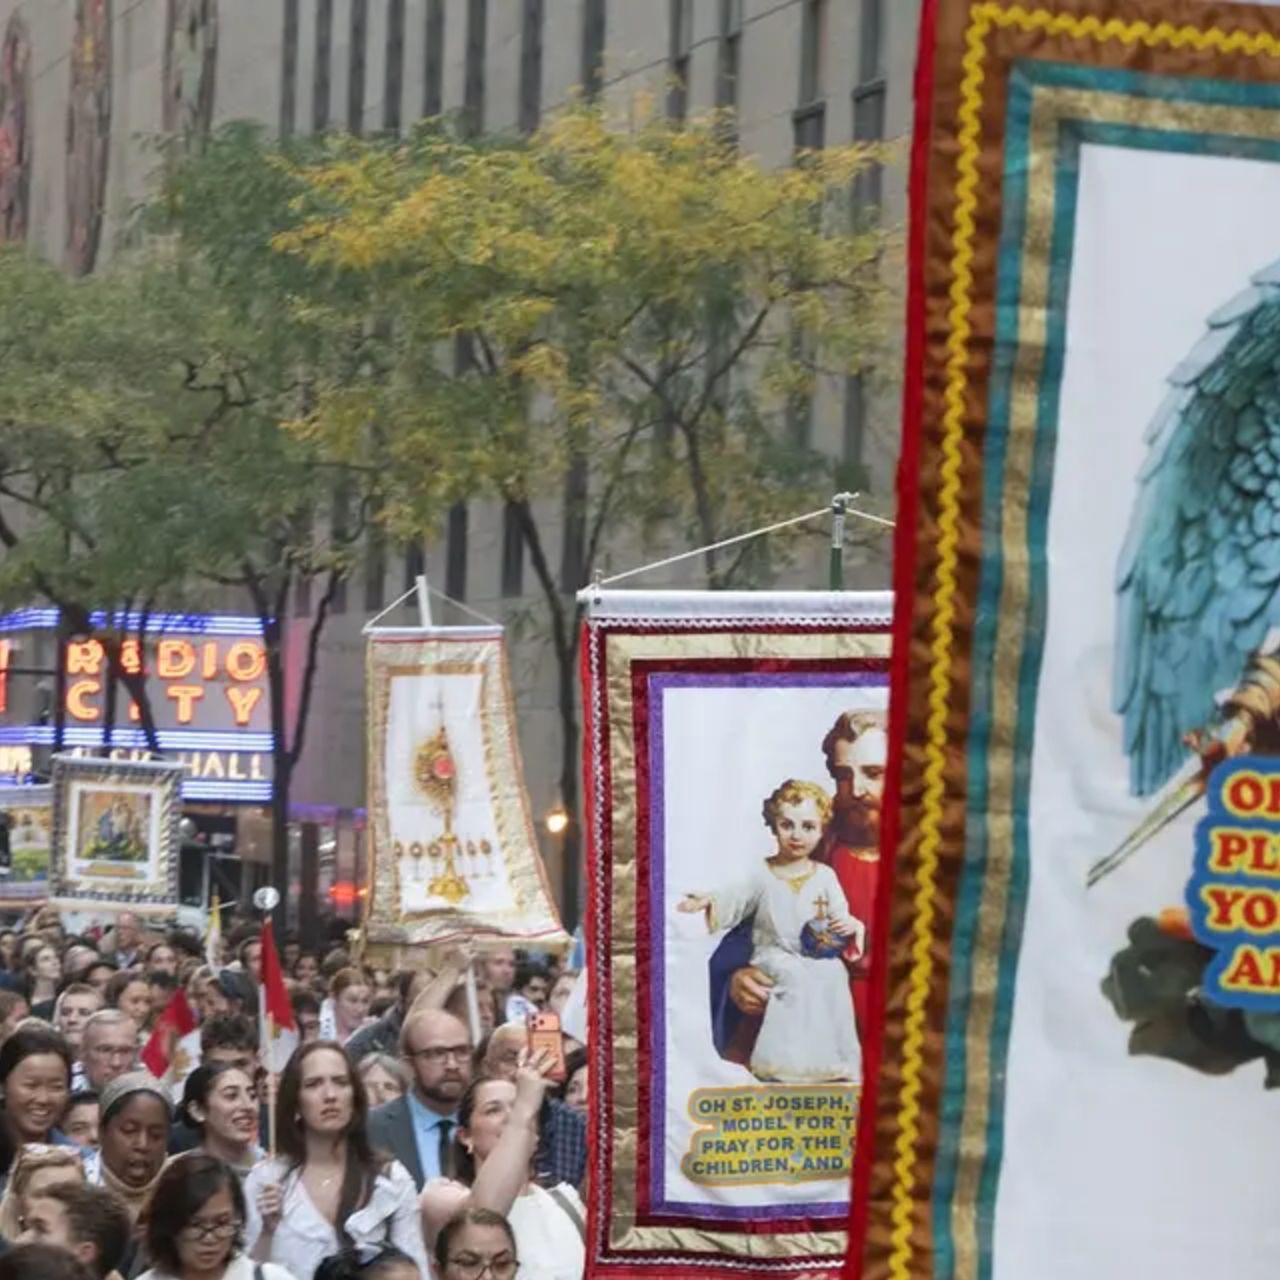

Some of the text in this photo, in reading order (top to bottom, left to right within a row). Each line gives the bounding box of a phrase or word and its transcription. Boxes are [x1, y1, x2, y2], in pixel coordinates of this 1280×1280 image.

[699, 1099, 725, 1113] OH
[732, 1097, 756, 1111] ST.
[764, 1096, 849, 1112] JOSEPH,
[723, 1117, 787, 1131] MODEL
[795, 1116, 834, 1129] FOR
[702, 1139, 750, 1154] PRAY
[757, 1137, 794, 1151] FOR
[801, 1135, 841, 1149] THE
[692, 1155, 844, 1174] CHILDREN, AND
